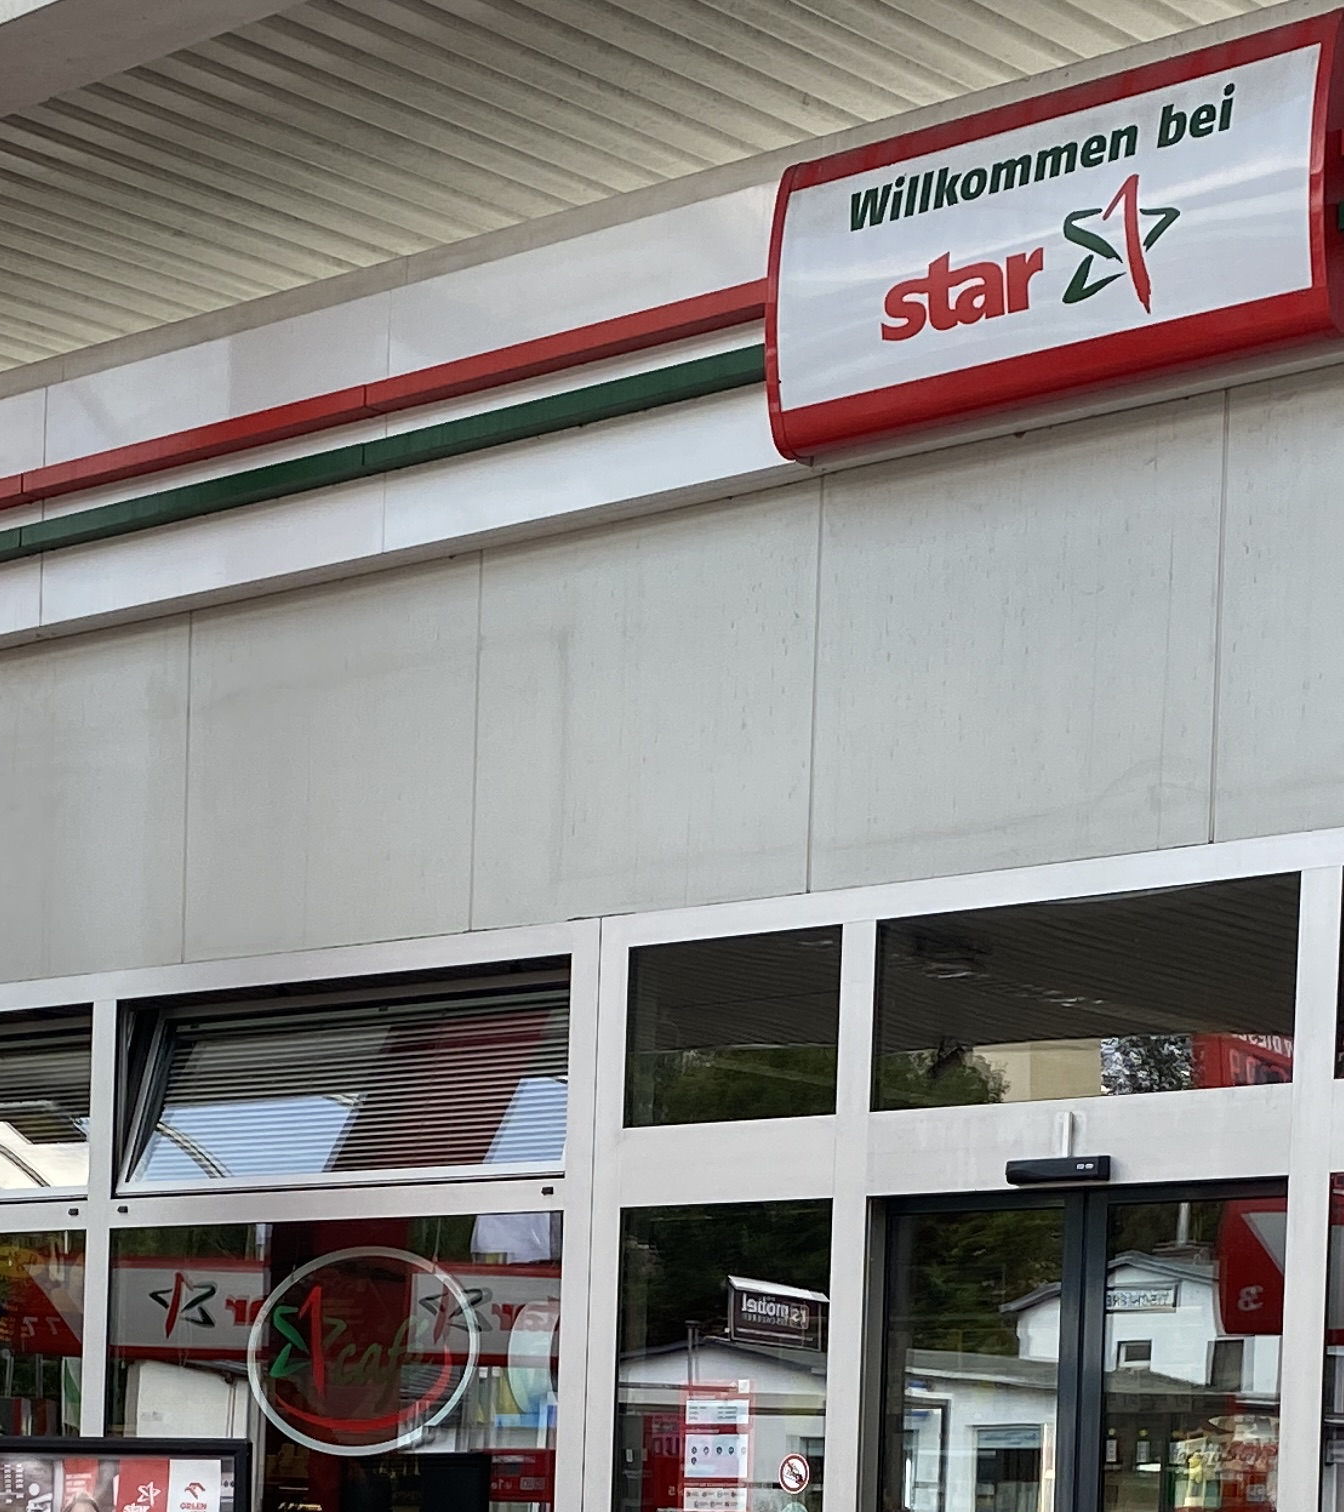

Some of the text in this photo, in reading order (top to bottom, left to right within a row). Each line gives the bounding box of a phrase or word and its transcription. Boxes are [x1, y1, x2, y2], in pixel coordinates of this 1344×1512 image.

[849, 82, 1237, 232] Willkommen bei
[880, 246, 1044, 341] star
